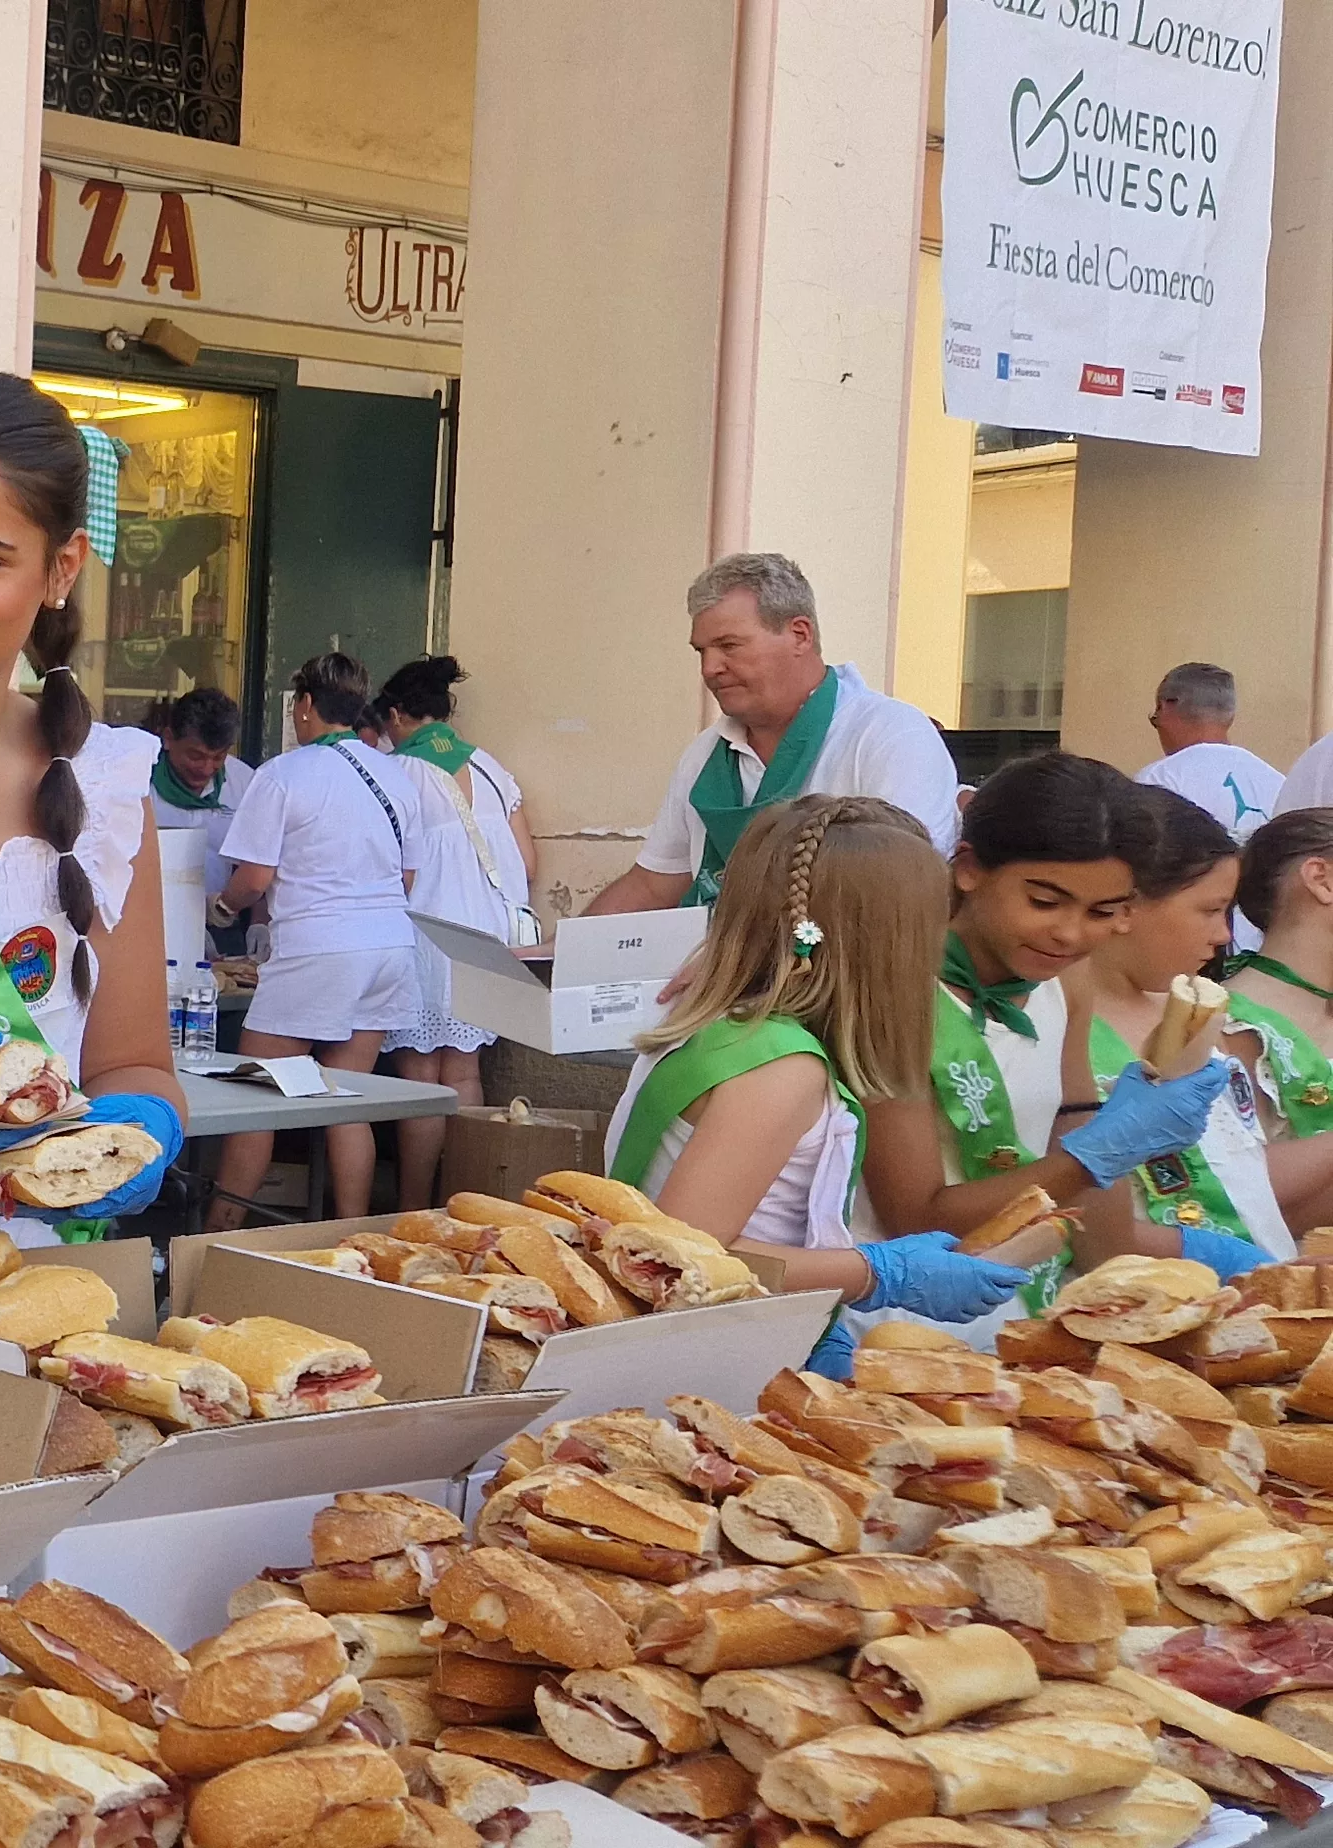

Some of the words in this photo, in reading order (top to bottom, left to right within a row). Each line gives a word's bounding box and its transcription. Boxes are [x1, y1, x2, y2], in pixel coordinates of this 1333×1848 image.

[1128, 0, 1271, 80] Lorenzo!
[1074, 97, 1217, 163] COMERCIO
[1073, 151, 1217, 221] HUESCA
[986, 223, 1058, 280] Fiesta
[1067, 240, 1100, 287] del
[1106, 246, 1215, 308] Comercio
[618, 937, 643, 949] 2142
